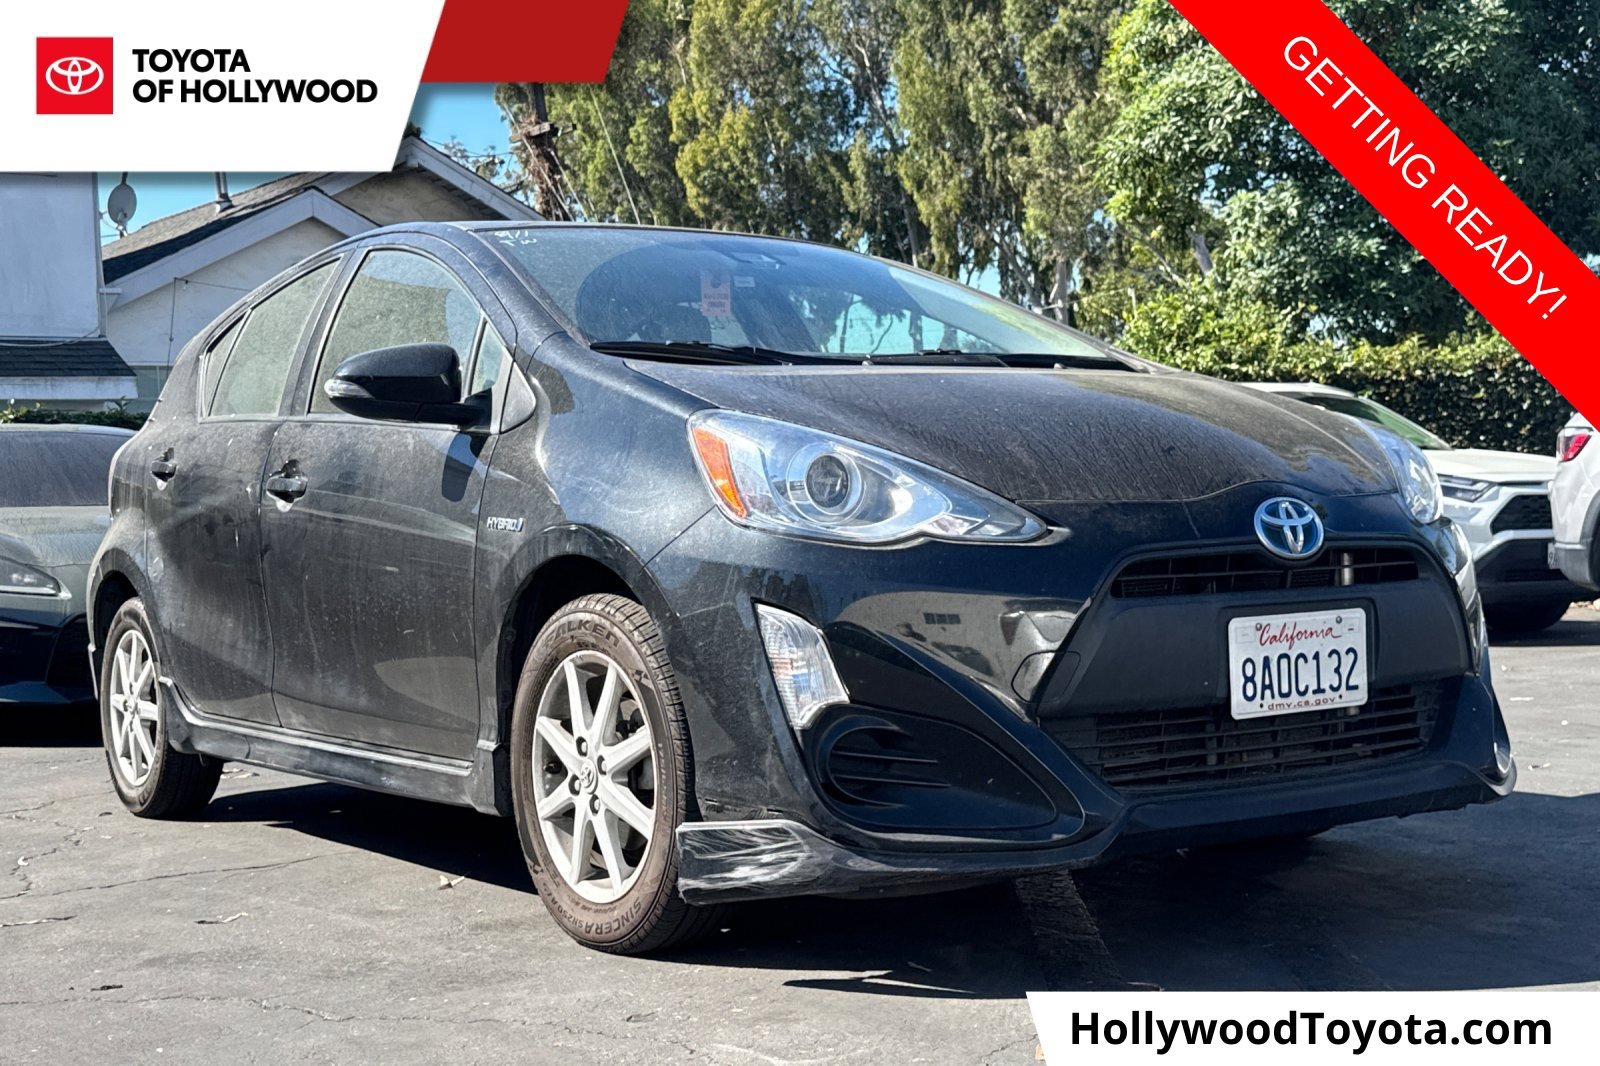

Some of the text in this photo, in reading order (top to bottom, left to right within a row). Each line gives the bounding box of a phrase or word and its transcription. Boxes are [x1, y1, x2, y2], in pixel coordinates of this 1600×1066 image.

[486, 517, 518, 531] HYBRID
[1258, 622, 1342, 651] California
[1267, 696, 1337, 711] dmv.ca.gov
[584, 895, 643, 936] SINCERA
